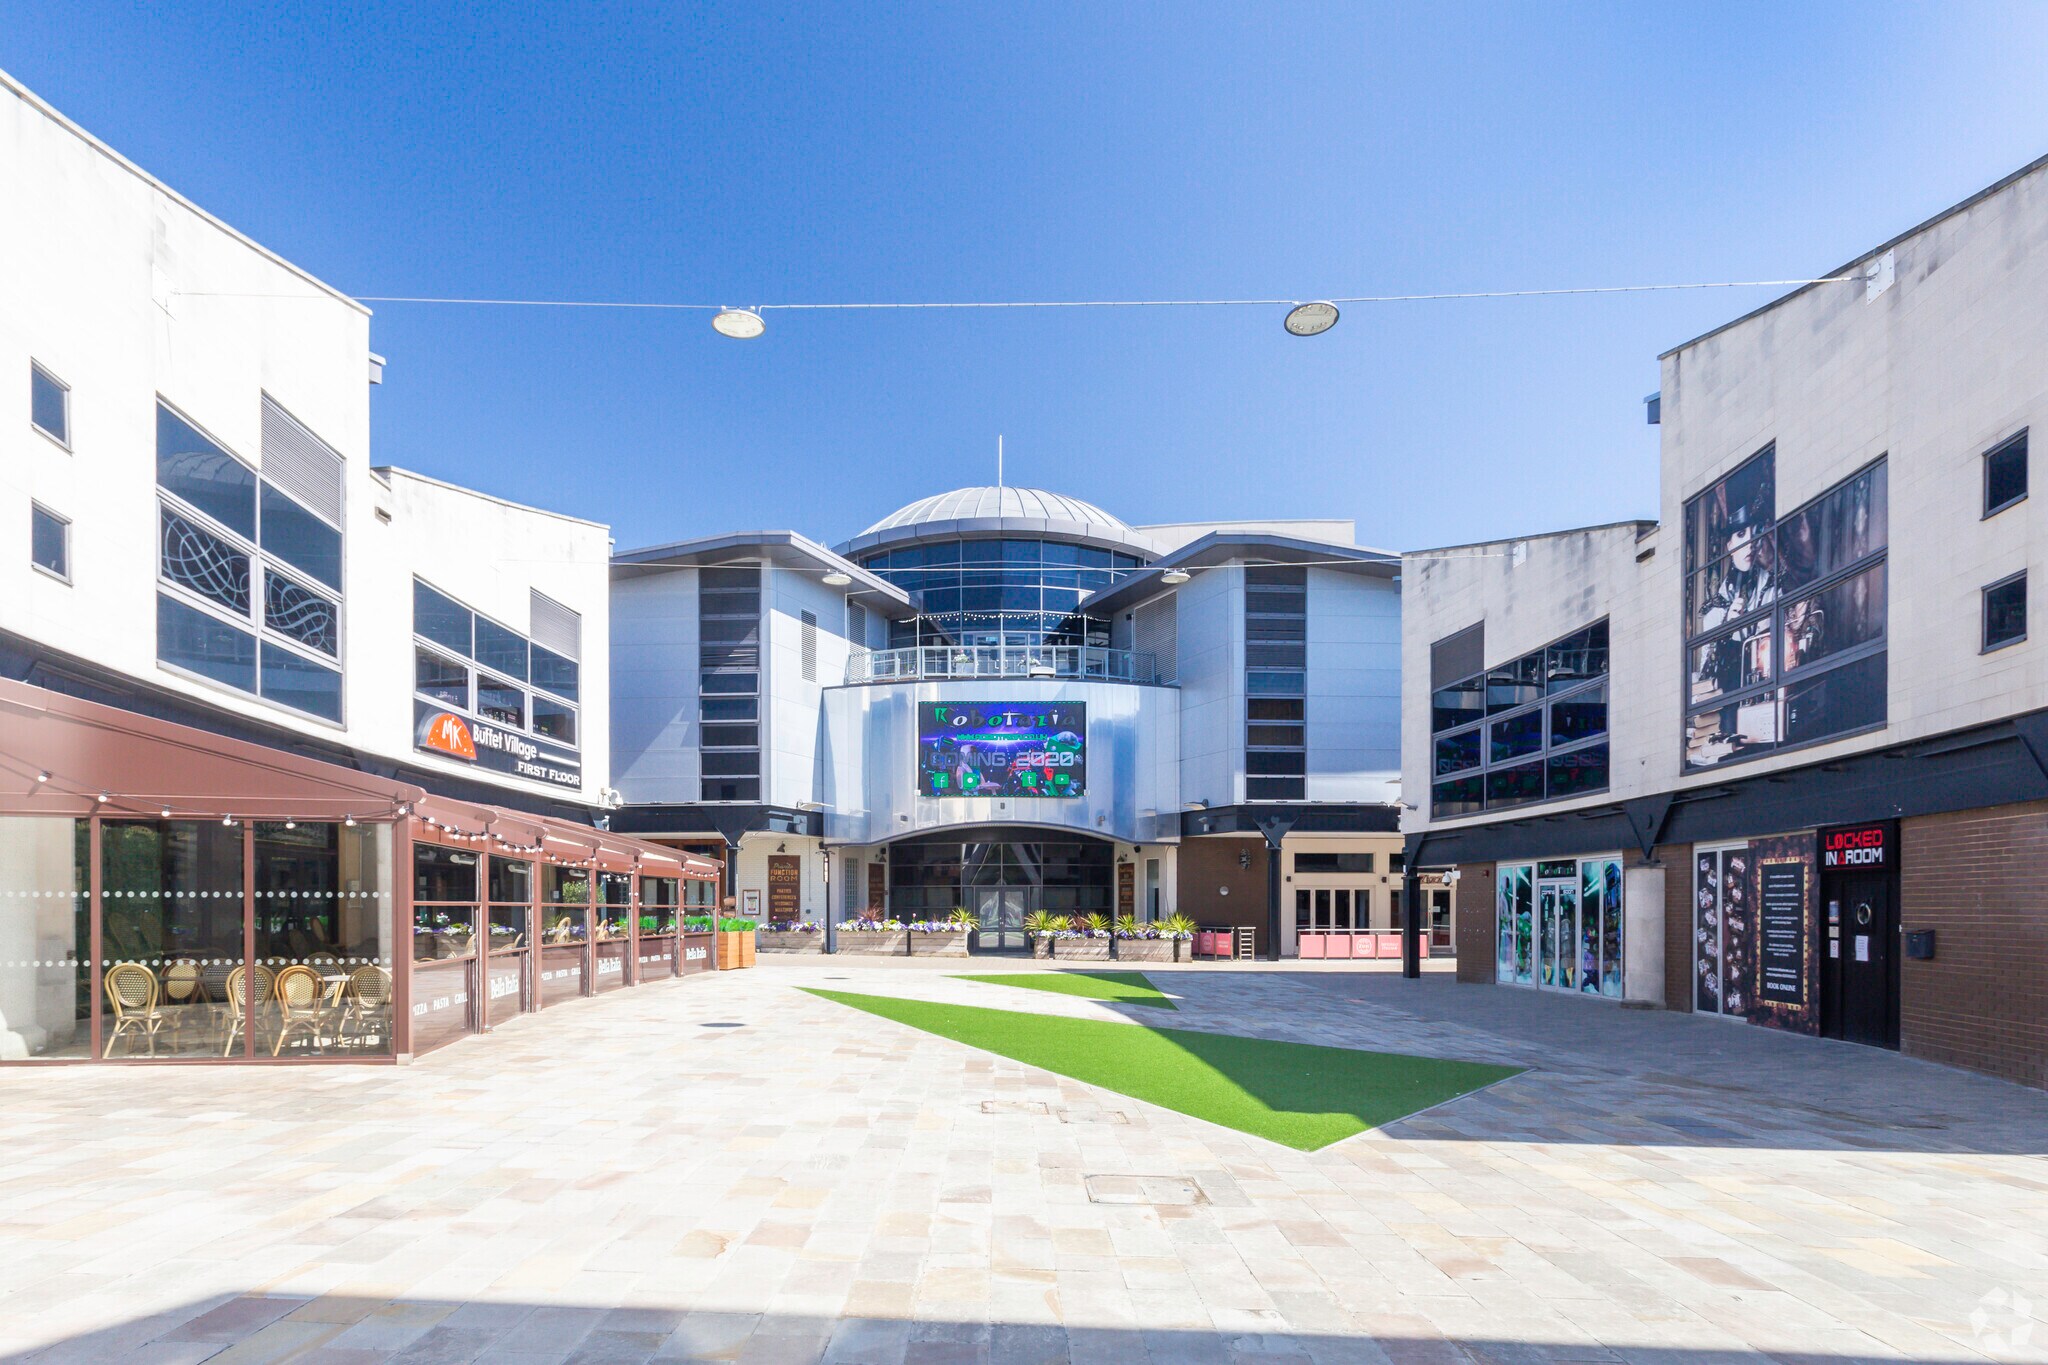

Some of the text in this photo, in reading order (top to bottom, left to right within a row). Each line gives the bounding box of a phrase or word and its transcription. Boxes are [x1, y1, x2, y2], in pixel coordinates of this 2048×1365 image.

[442, 719, 463, 749] MK
[473, 723, 537, 760] Buffet Village
[931, 751, 1074, 767] COMING 2020
[518, 762, 580, 786] FIRST FLOOR
[1826, 829, 1883, 850] LOCKED
[1826, 851, 1837, 866] IN
[1845, 847, 1883, 864] ROOM
[490, 973, 519, 1000] Bella Italia
[1766, 981, 1796, 992] BOOK ONLINE
[433, 996, 449, 1011] PASTA
[454, 992, 468, 1004] GRILL
